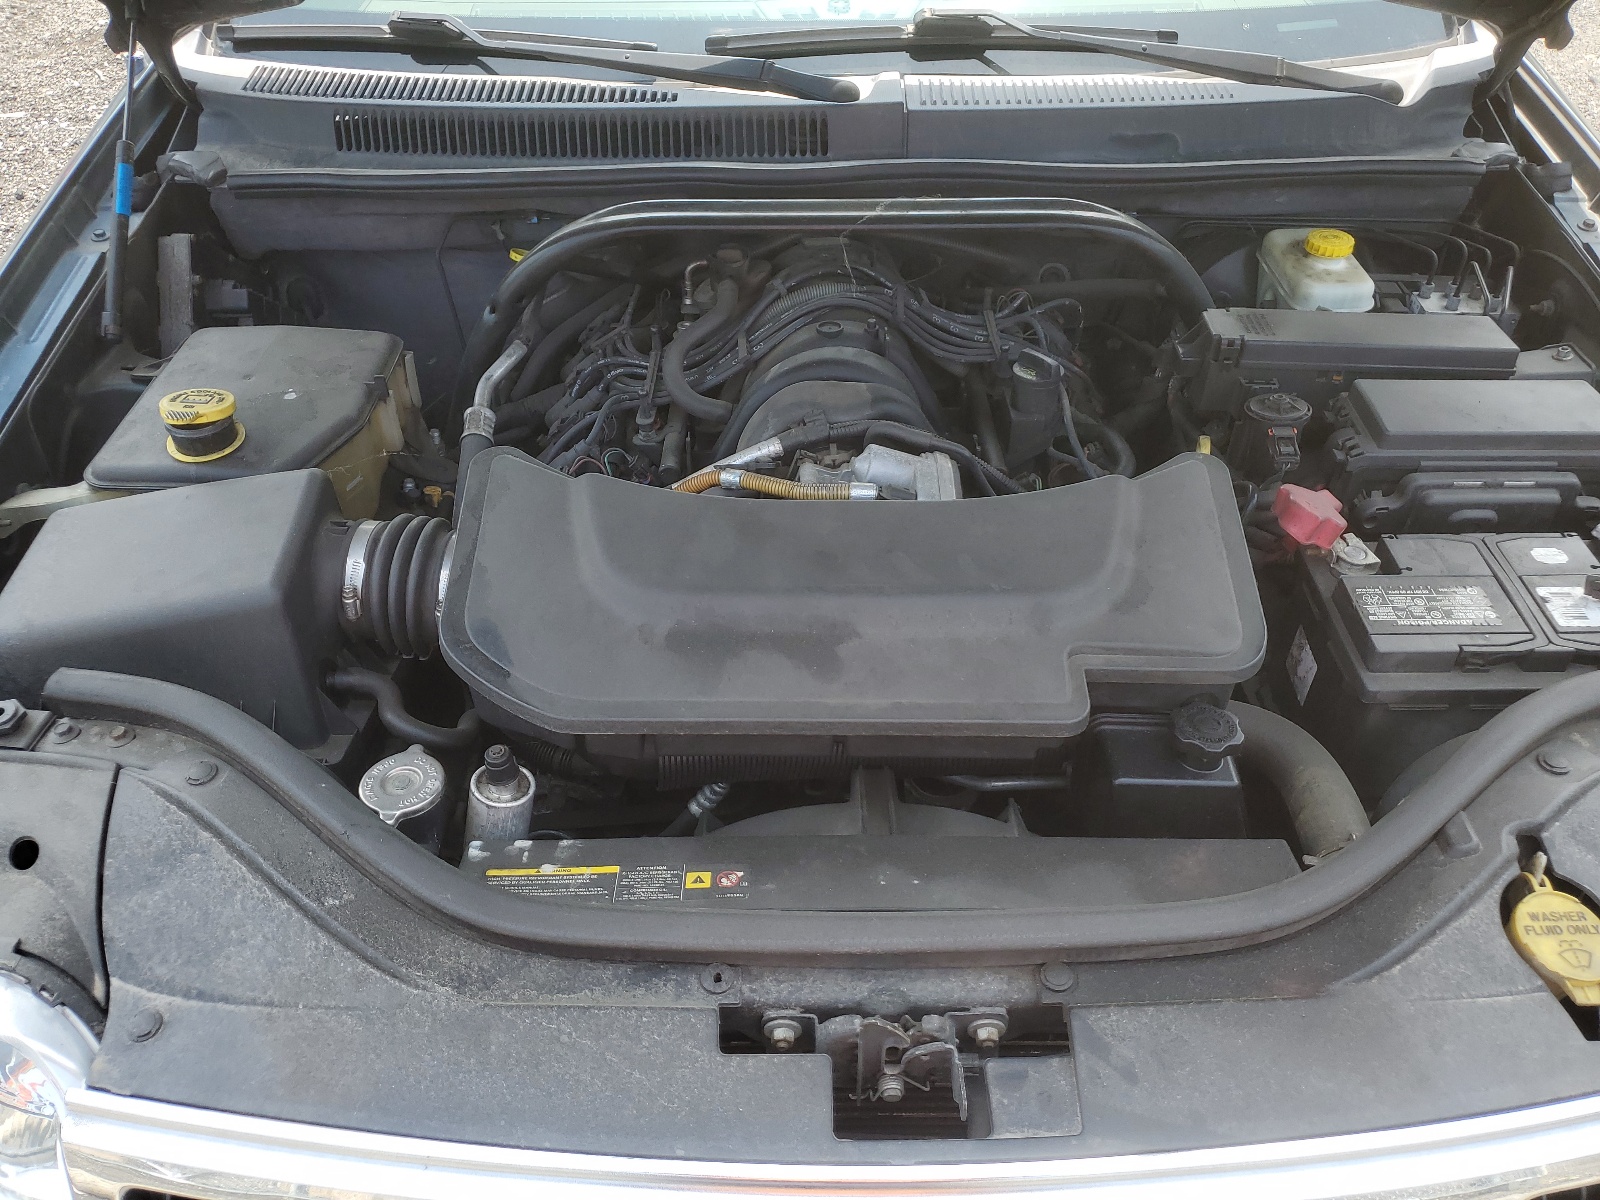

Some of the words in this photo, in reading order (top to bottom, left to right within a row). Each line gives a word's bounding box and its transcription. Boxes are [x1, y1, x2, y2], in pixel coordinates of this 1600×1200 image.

[424, 764, 437, 776] NOT
[418, 778, 436, 797] OPEN
[398, 796, 418, 807] HOT
[1527, 911, 1587, 922] WASHER
[1523, 925, 1563, 935] FLUID
[1566, 924, 1600, 934] ONLY
